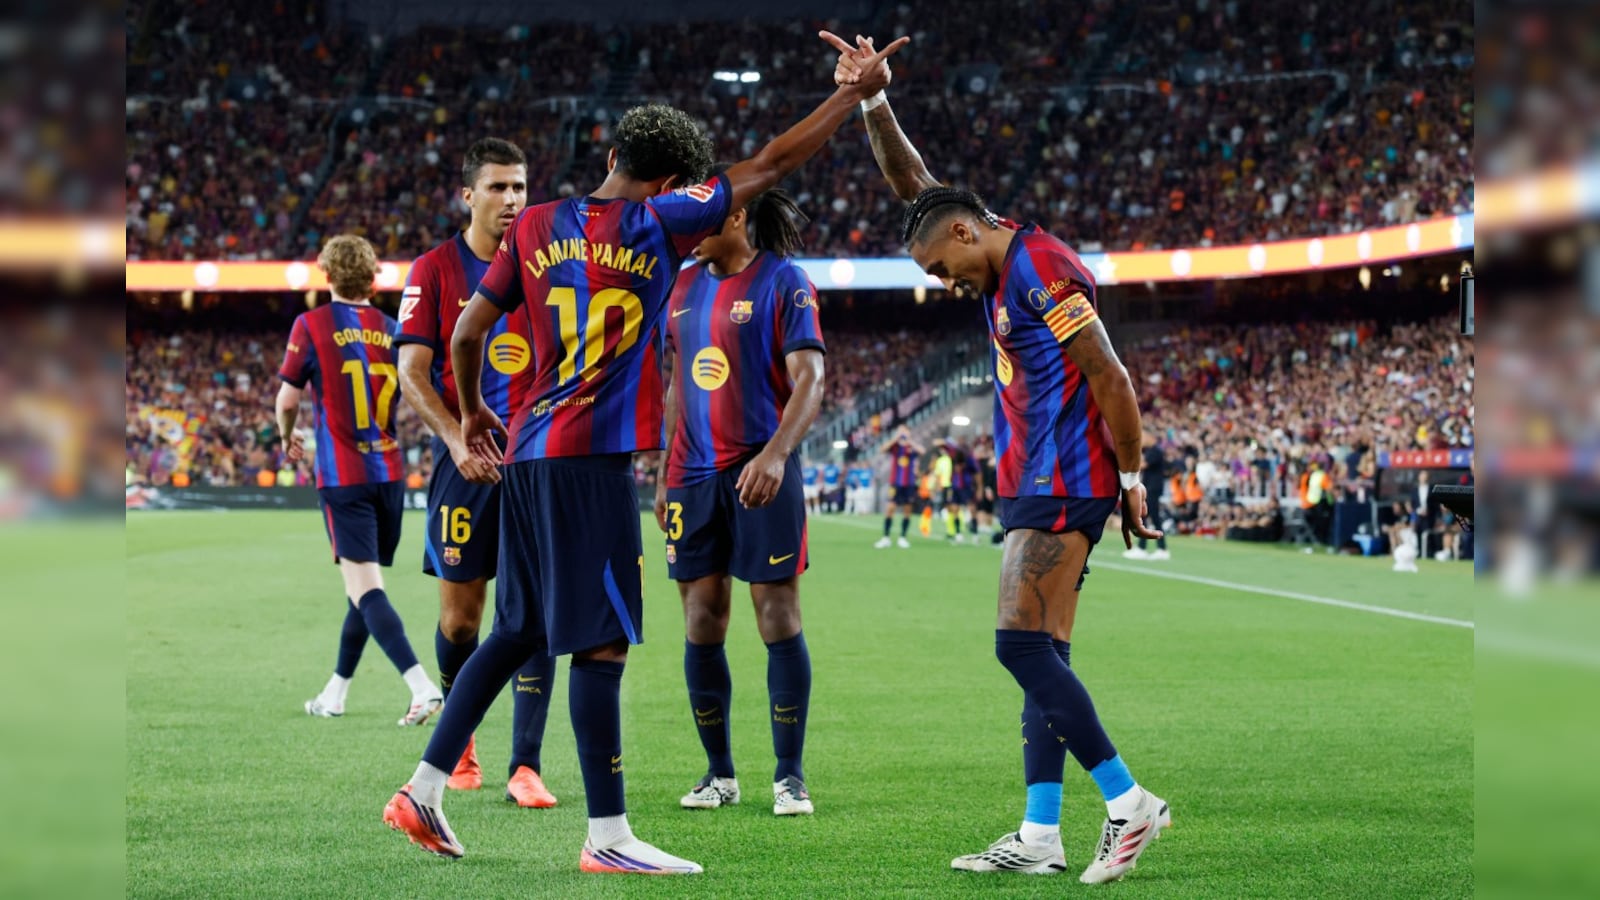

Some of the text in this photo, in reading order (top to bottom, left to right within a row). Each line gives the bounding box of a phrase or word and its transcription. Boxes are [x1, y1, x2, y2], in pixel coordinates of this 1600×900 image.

[525, 238, 659, 279] LAMINE YAMAL
[333, 328, 393, 350] GORDON
[545, 287, 643, 386] 10
[341, 359, 398, 431] 17
[440, 505, 471, 544] 16
[664, 502, 683, 540] 3
